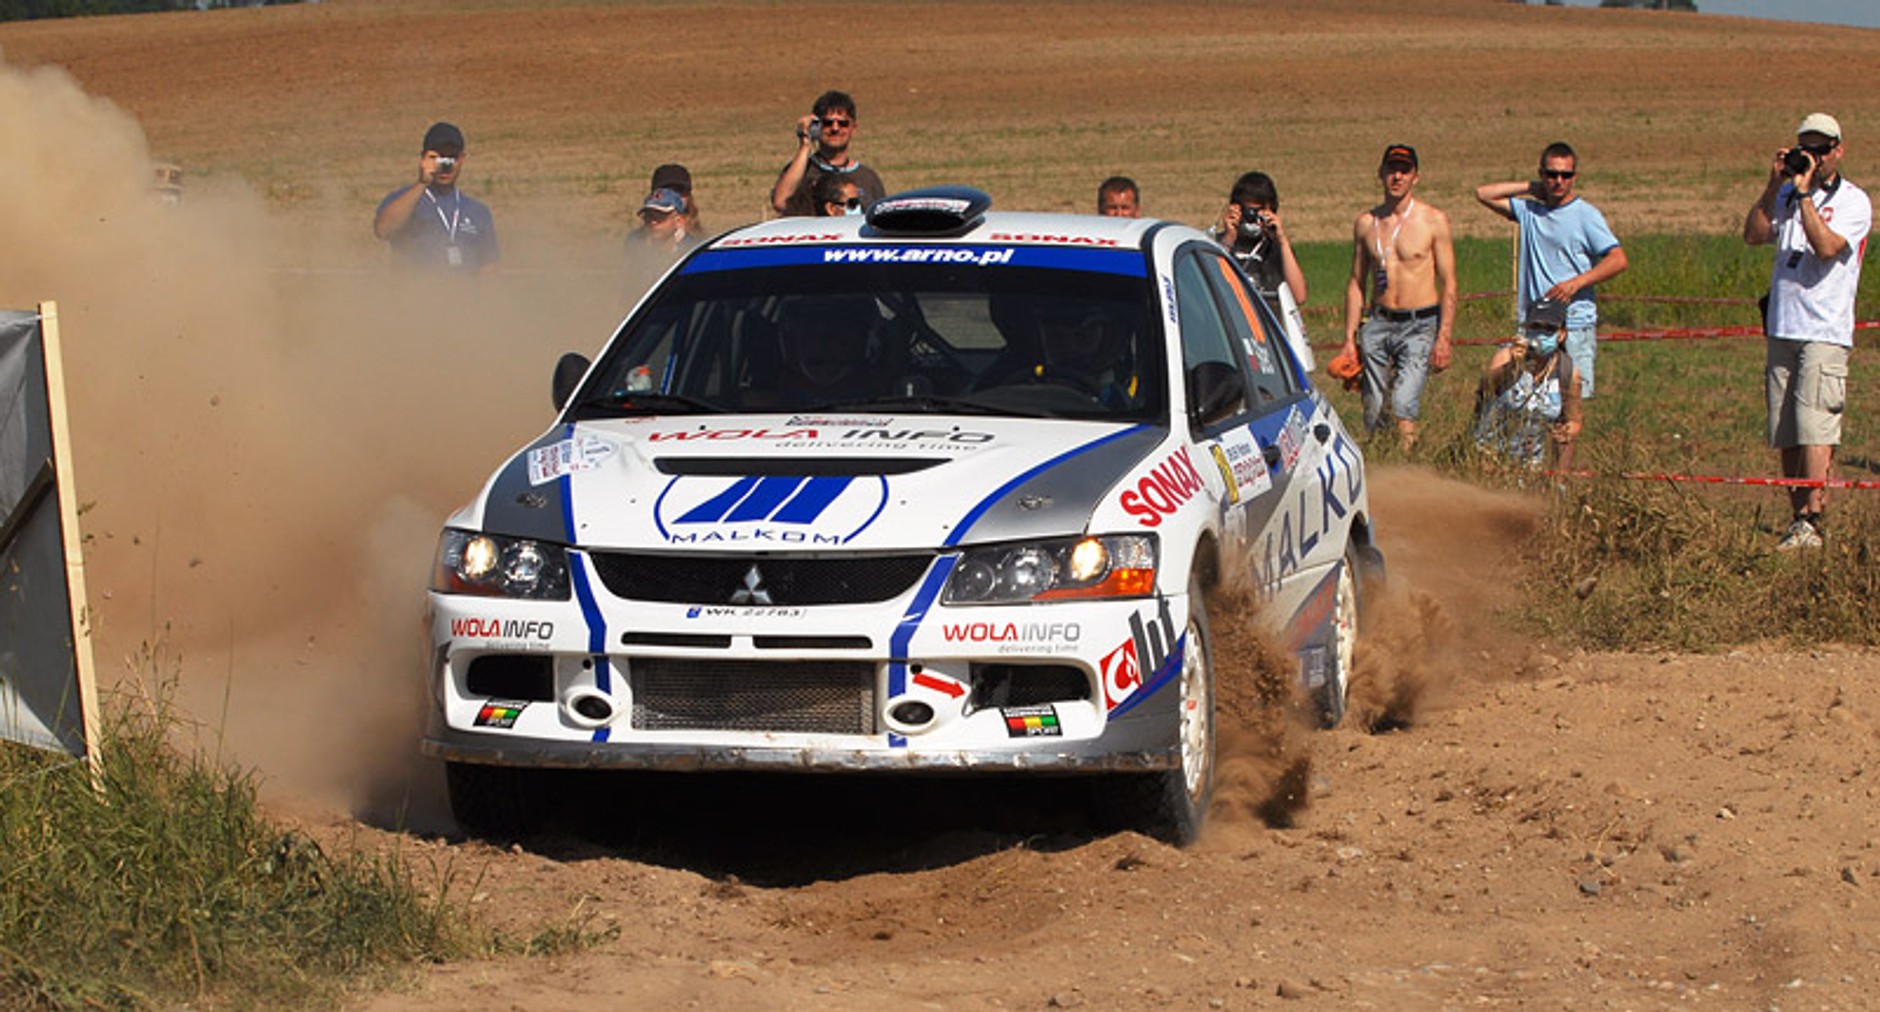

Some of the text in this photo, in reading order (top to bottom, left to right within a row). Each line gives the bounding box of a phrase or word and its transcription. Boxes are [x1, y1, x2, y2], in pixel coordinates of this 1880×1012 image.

[721, 232, 842, 247] SONAX
[990, 233, 1121, 247] SONAX
[824, 248, 1015, 267] www.arno.pl
[649, 428, 995, 443] WOLA INFO
[1120, 443, 1205, 527] SONAX
[671, 528, 841, 546] MALKOM
[451, 618, 554, 640] WOLA INFO
[943, 622, 1081, 642] WOLA INFO
